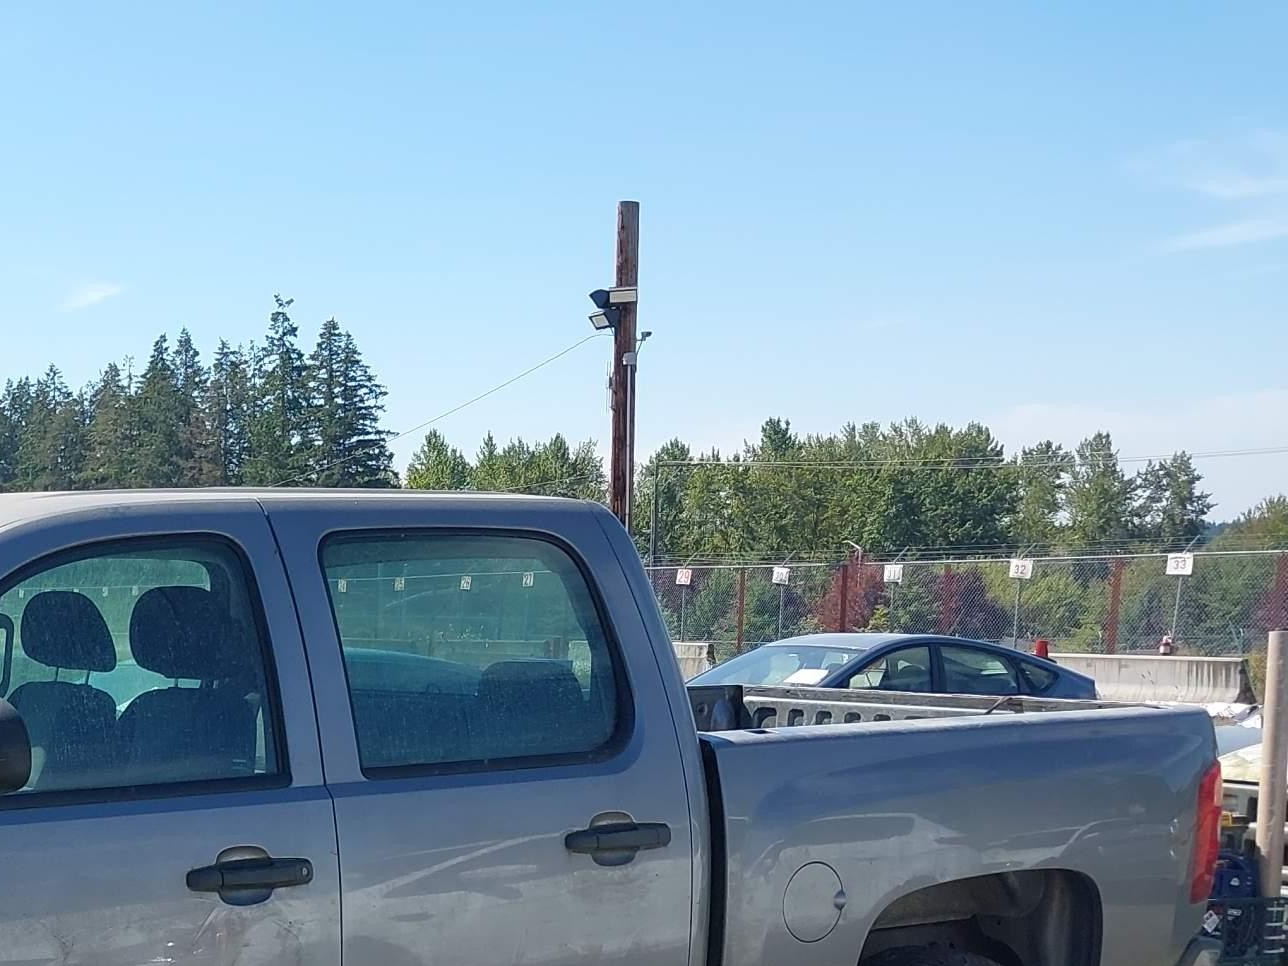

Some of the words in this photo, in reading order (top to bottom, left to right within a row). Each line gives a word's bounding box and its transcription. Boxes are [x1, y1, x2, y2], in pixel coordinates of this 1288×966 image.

[1014, 564, 1027, 575] 32
[1174, 559, 1187, 570] 33
[523, 573, 533, 585] 27
[678, 570, 690, 583] 29
